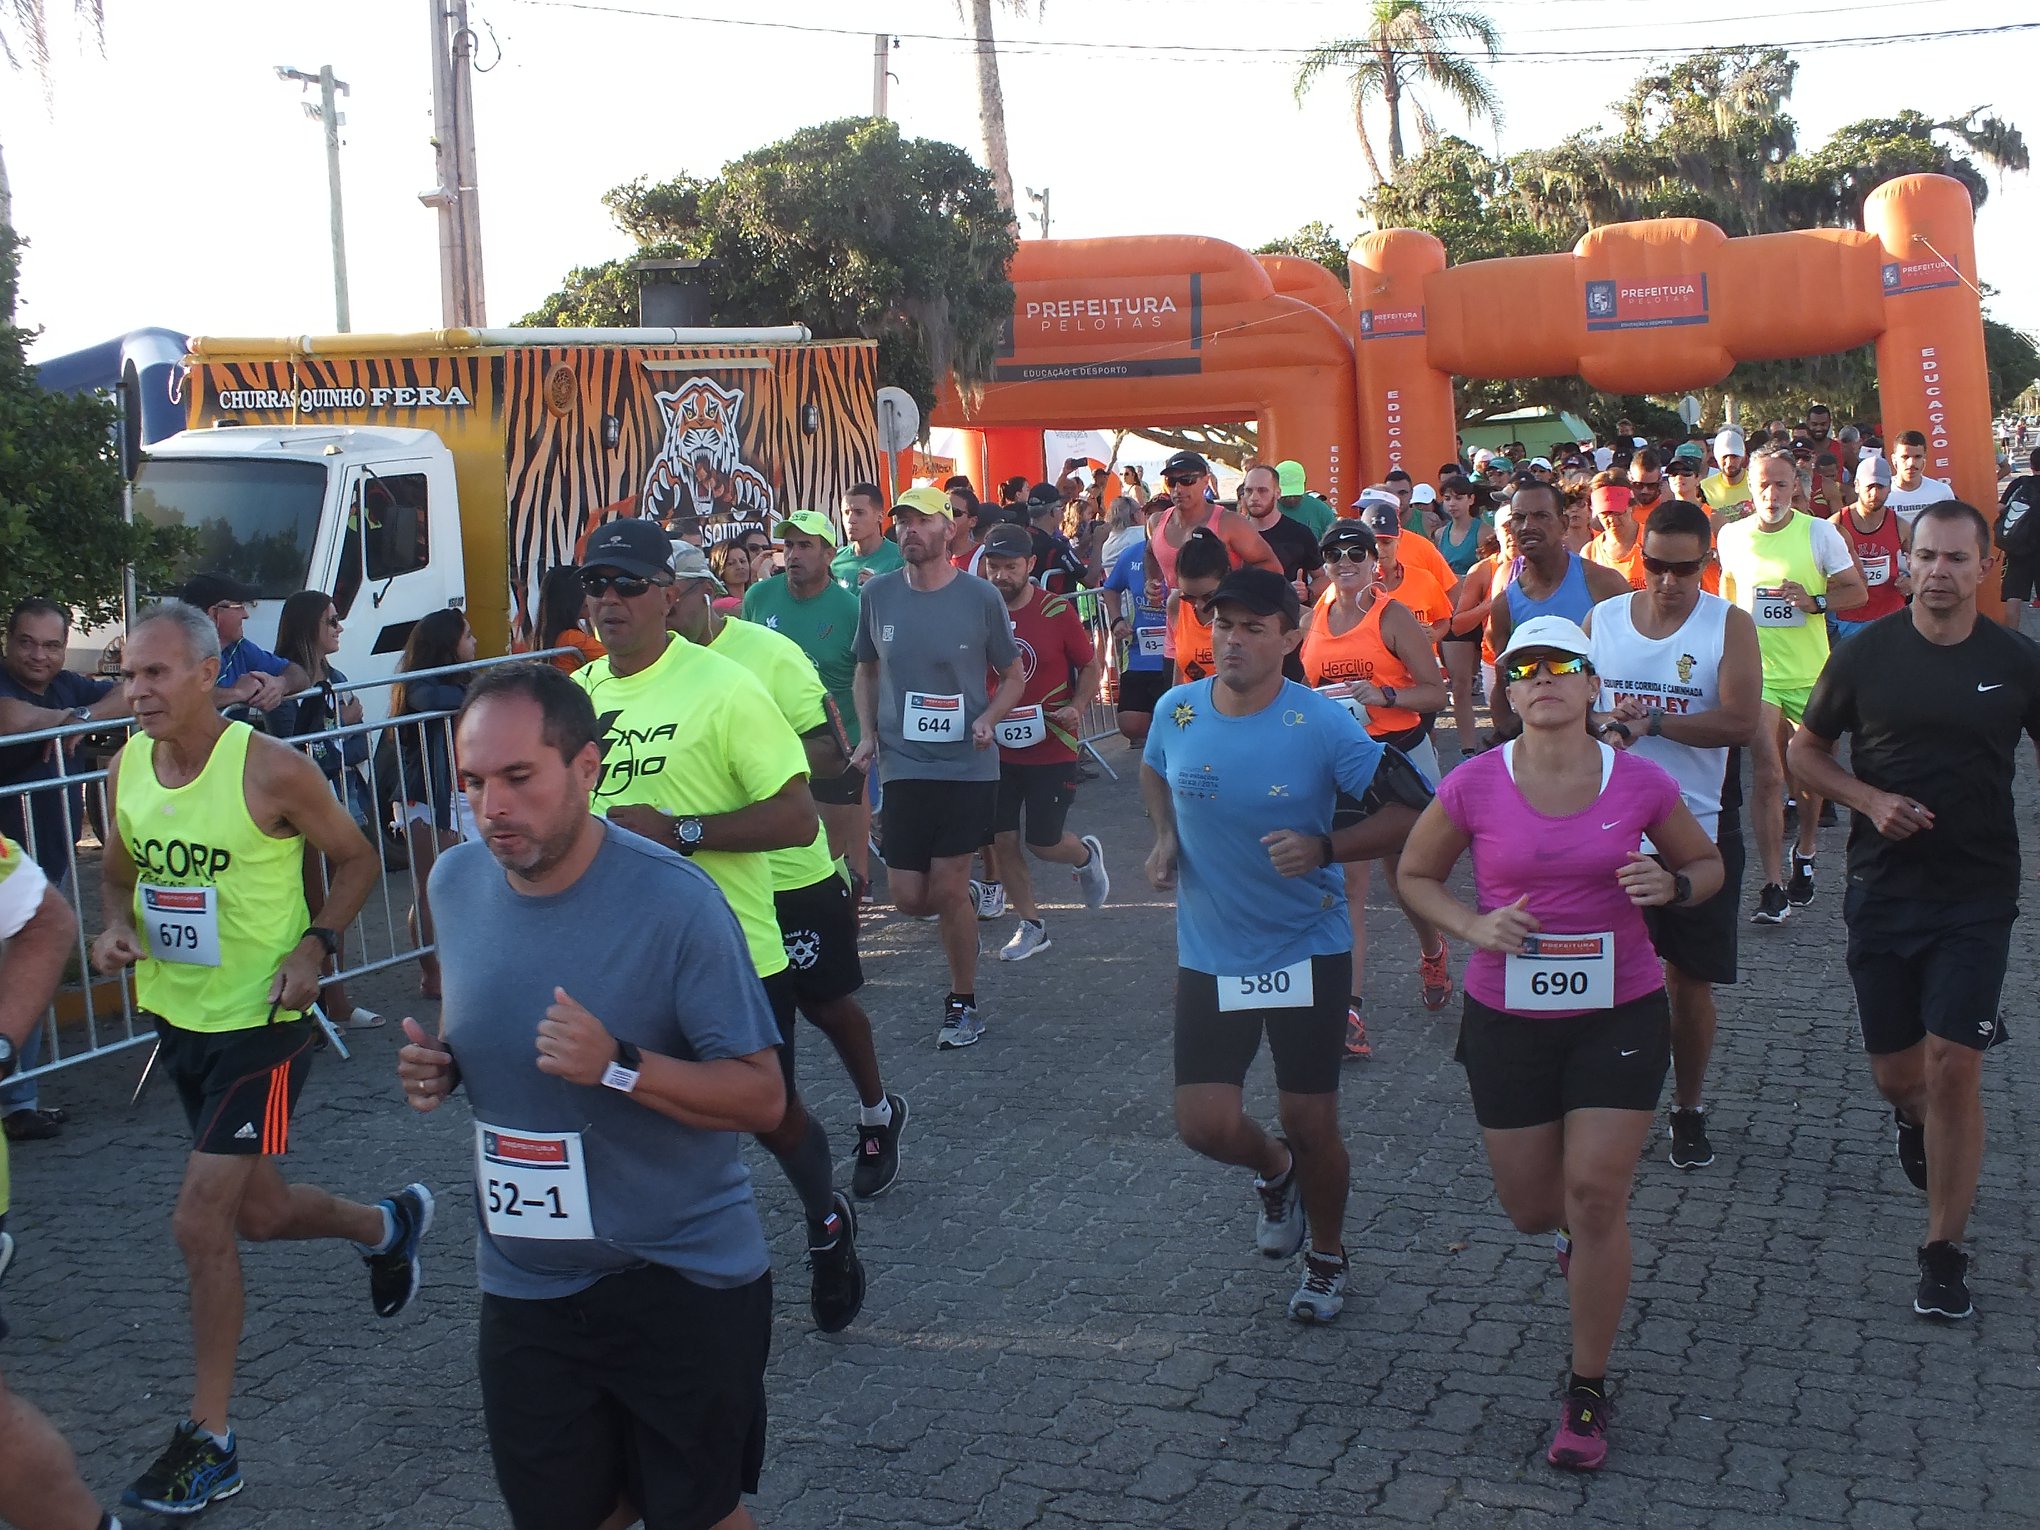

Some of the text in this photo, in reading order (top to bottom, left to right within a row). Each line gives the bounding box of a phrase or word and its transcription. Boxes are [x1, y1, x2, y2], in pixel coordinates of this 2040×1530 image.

[1621, 285, 1694, 298] PREFEITURA
[1026, 296, 1176, 318] PREFEITURA
[1041, 316, 1162, 332] PELOTAS
[1374, 312, 1418, 320] PREFEITURA
[1023, 367, 1070, 378] EDUCAÇÃO
[1080, 366, 1128, 376] DESPORTO
[219, 386, 470, 412] CHURRASQUINHO FERA
[1921, 347, 1948, 448] EDUCAÇÃO
[1865, 571, 1882, 580] 26
[1763, 605, 1792, 619] 668
[1322, 659, 1374, 677] Hercilio
[1624, 680, 1634, 689] DE
[1634, 681, 1661, 692] CORRIDA
[1662, 684, 1667, 692] E
[1667, 685, 1703, 697] CAMINHADA
[918, 717, 951, 733] 644
[1004, 726, 1033, 741] 623
[132, 837, 231, 879] SCORP
[159, 922, 199, 949] 679
[1240, 970, 1291, 995] 580
[1531, 971, 1588, 996] 690
[488, 1178, 569, 1218] 52-1
